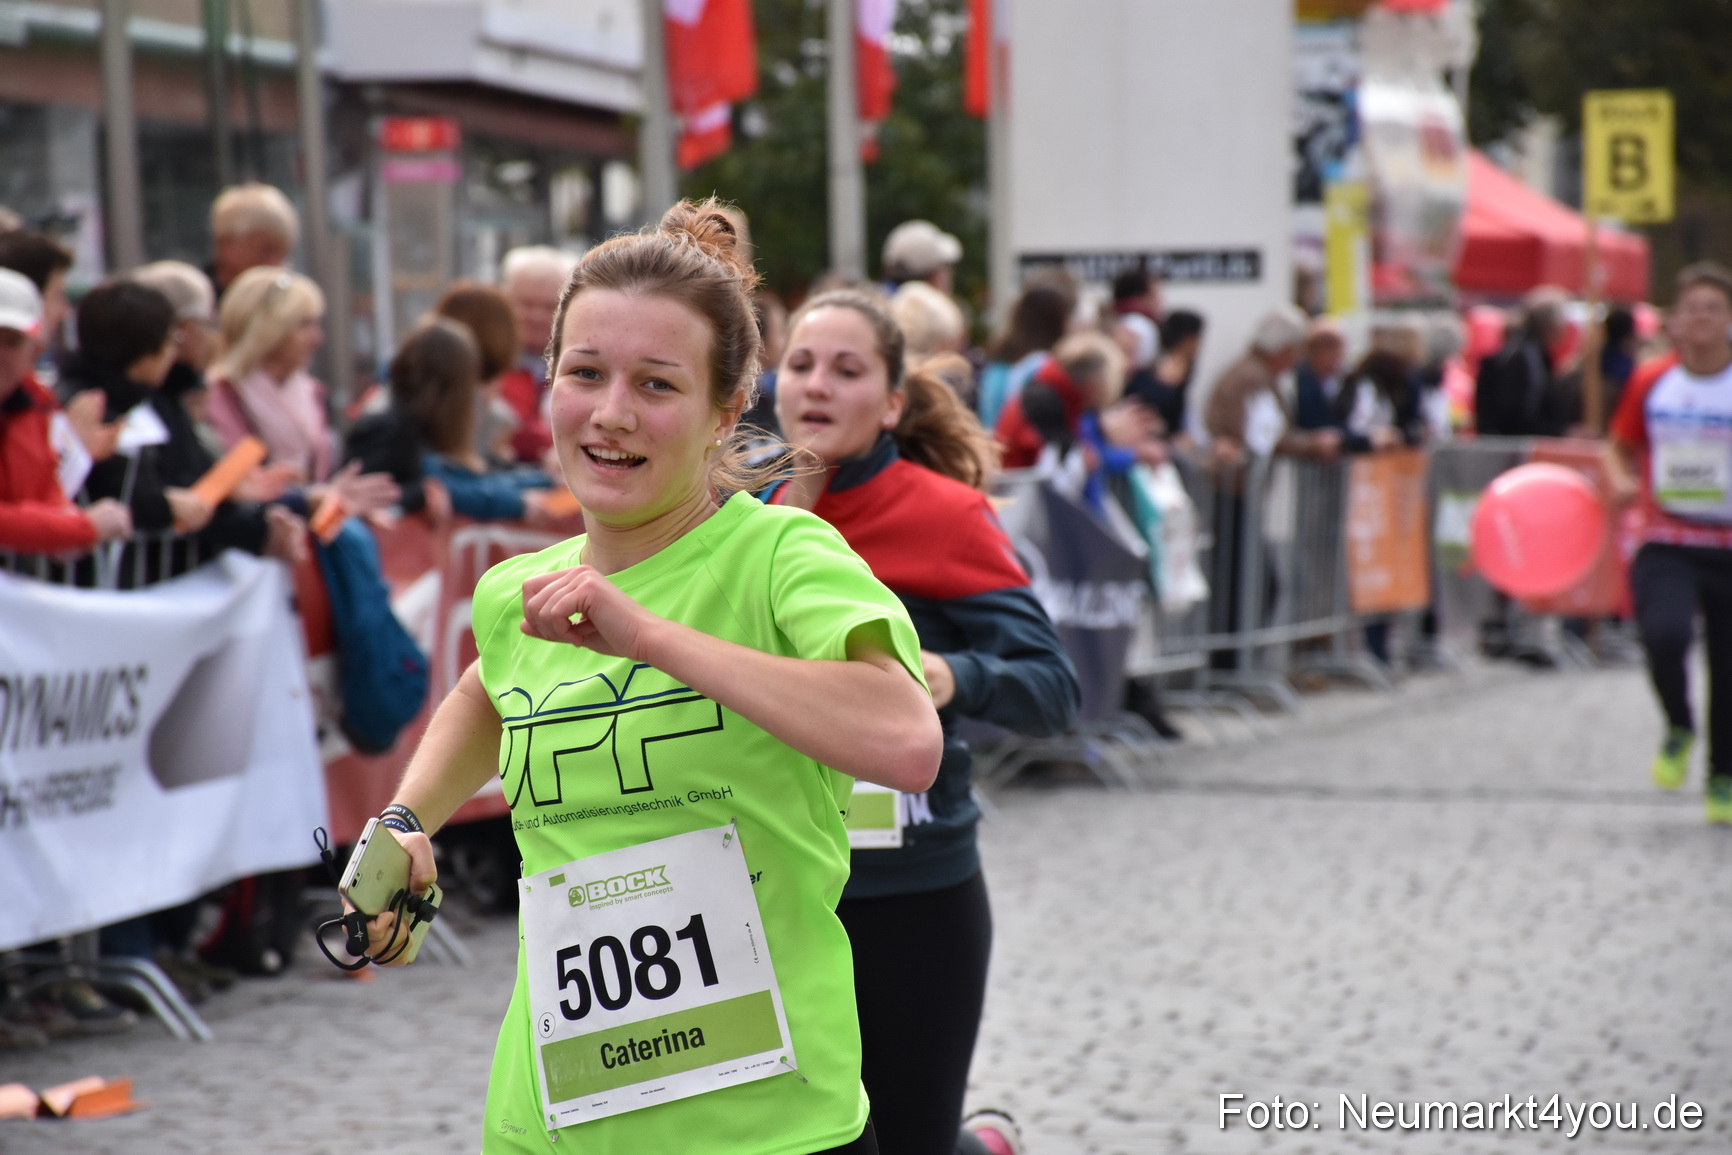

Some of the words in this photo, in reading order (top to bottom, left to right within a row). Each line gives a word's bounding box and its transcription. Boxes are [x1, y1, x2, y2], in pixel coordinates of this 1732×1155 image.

[1609, 134, 1648, 191] B
[384, 819, 410, 832] APTAIN
[525, 815, 540, 830] und
[542, 796, 685, 826] Automatisierungstechnik
[687, 786, 734, 804] GmbH
[585, 865, 671, 903] BOCK
[589, 900, 614, 911] inspired
[615, 897, 624, 905] by
[624, 892, 643, 903] smart
[643, 886, 674, 898] concepts
[556, 913, 719, 1021] 5081
[542, 1018, 551, 1033] S
[600, 1026, 706, 1070] Caterina
